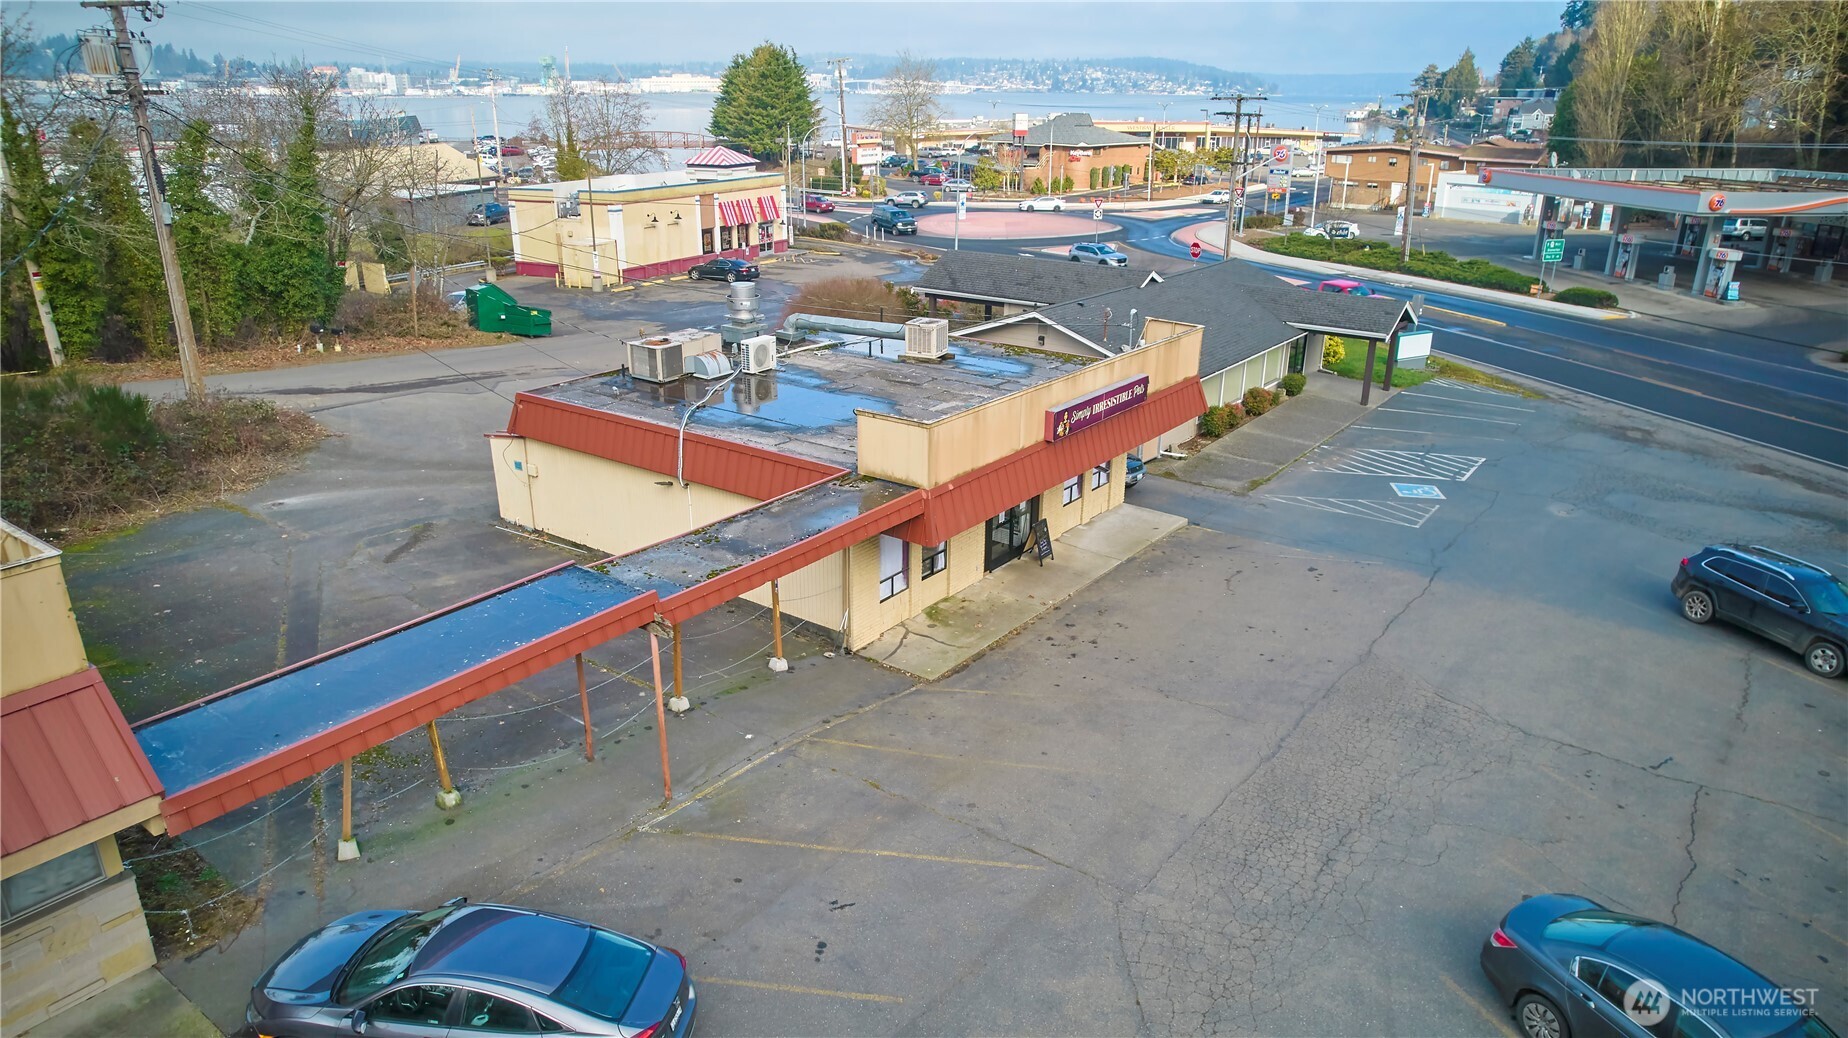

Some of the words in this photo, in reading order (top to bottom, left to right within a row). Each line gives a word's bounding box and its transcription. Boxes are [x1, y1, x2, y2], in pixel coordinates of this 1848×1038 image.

[1715, 199, 1724, 207] 76
[1071, 406, 1092, 424] Simply
[1092, 388, 1132, 414] IRRESISTIBLE
